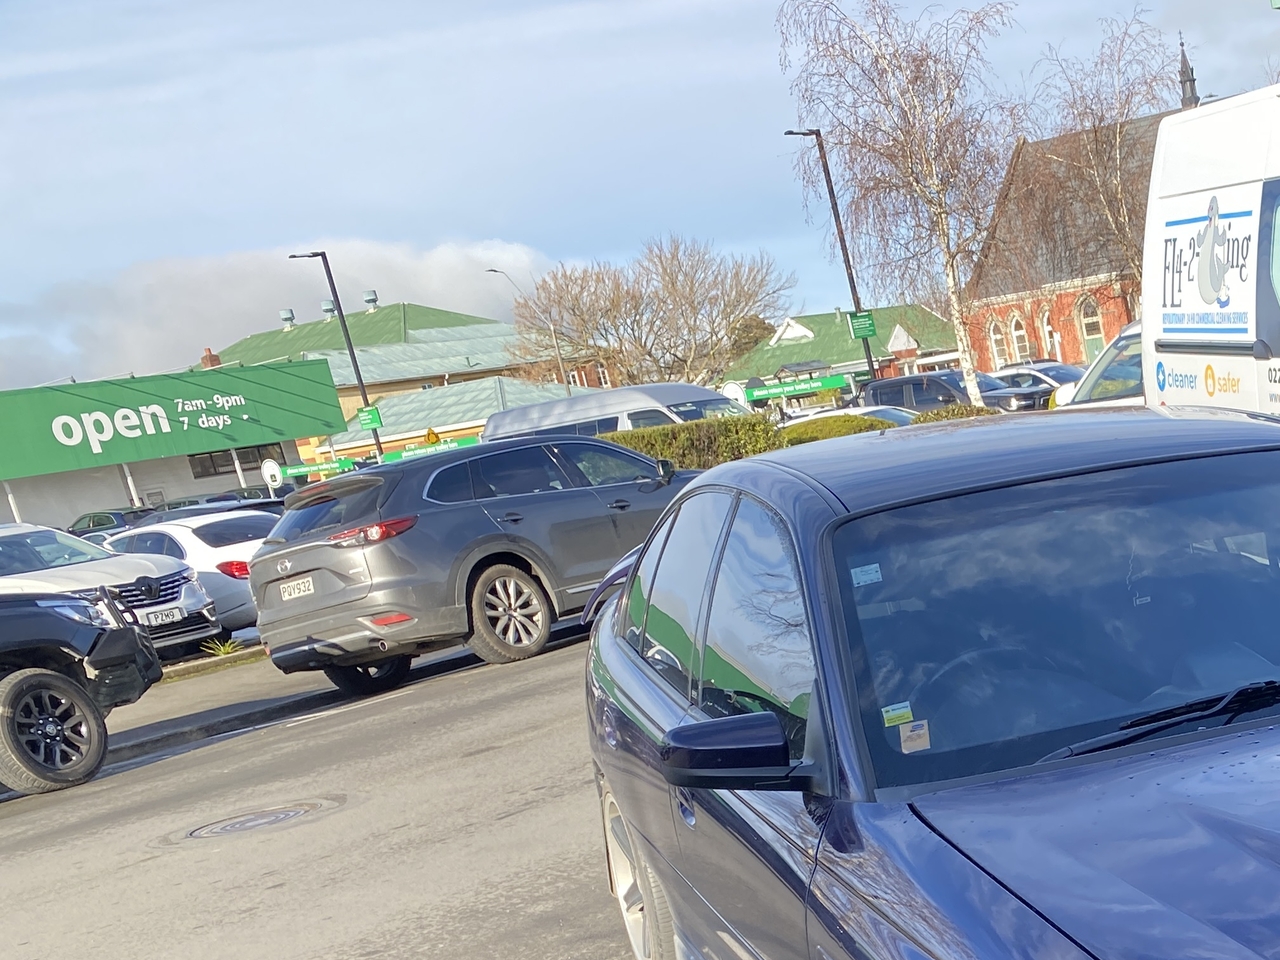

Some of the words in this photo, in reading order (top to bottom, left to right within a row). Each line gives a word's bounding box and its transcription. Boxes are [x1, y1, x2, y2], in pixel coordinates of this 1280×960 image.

[1168, 368, 1198, 390] cleaner
[1218, 372, 1240, 394] safer
[52, 404, 171, 454] open
[179, 417, 189, 430] 7
[198, 414, 232, 430] days
[282, 579, 312, 598] PQY932
[154, 611, 175, 621] PZM9
